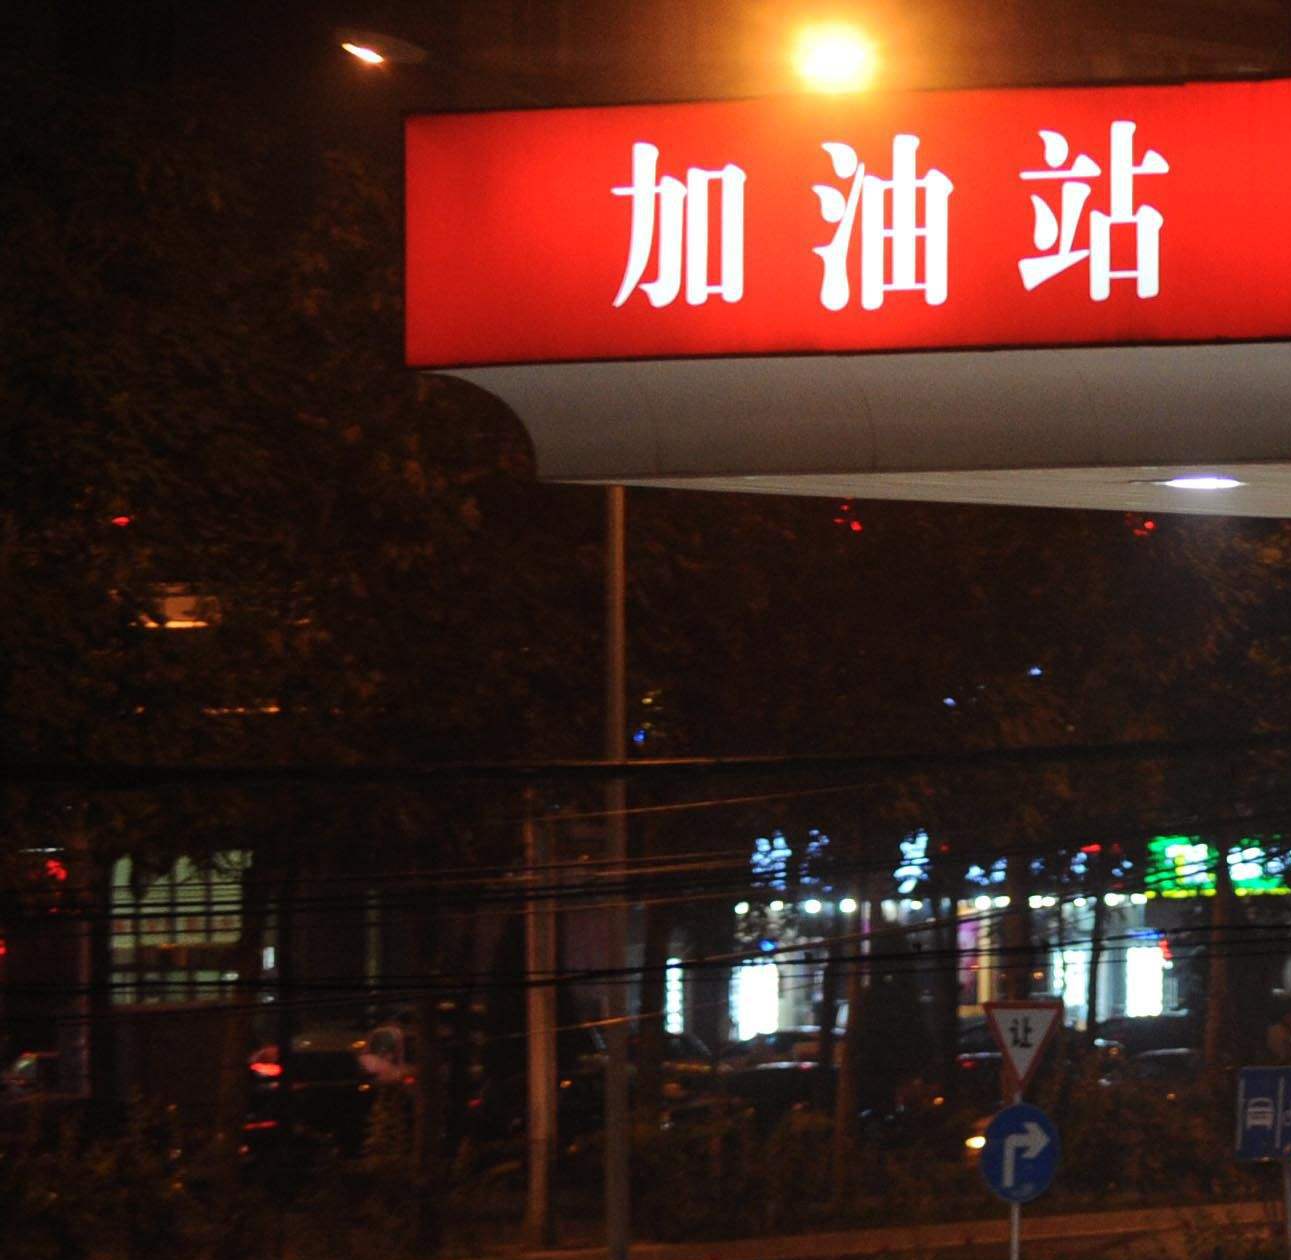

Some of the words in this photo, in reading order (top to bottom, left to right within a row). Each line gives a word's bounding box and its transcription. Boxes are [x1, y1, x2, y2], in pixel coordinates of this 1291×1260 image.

[611, 120, 1170, 311] 加油站
[1008, 1016, 1034, 1049] 让
